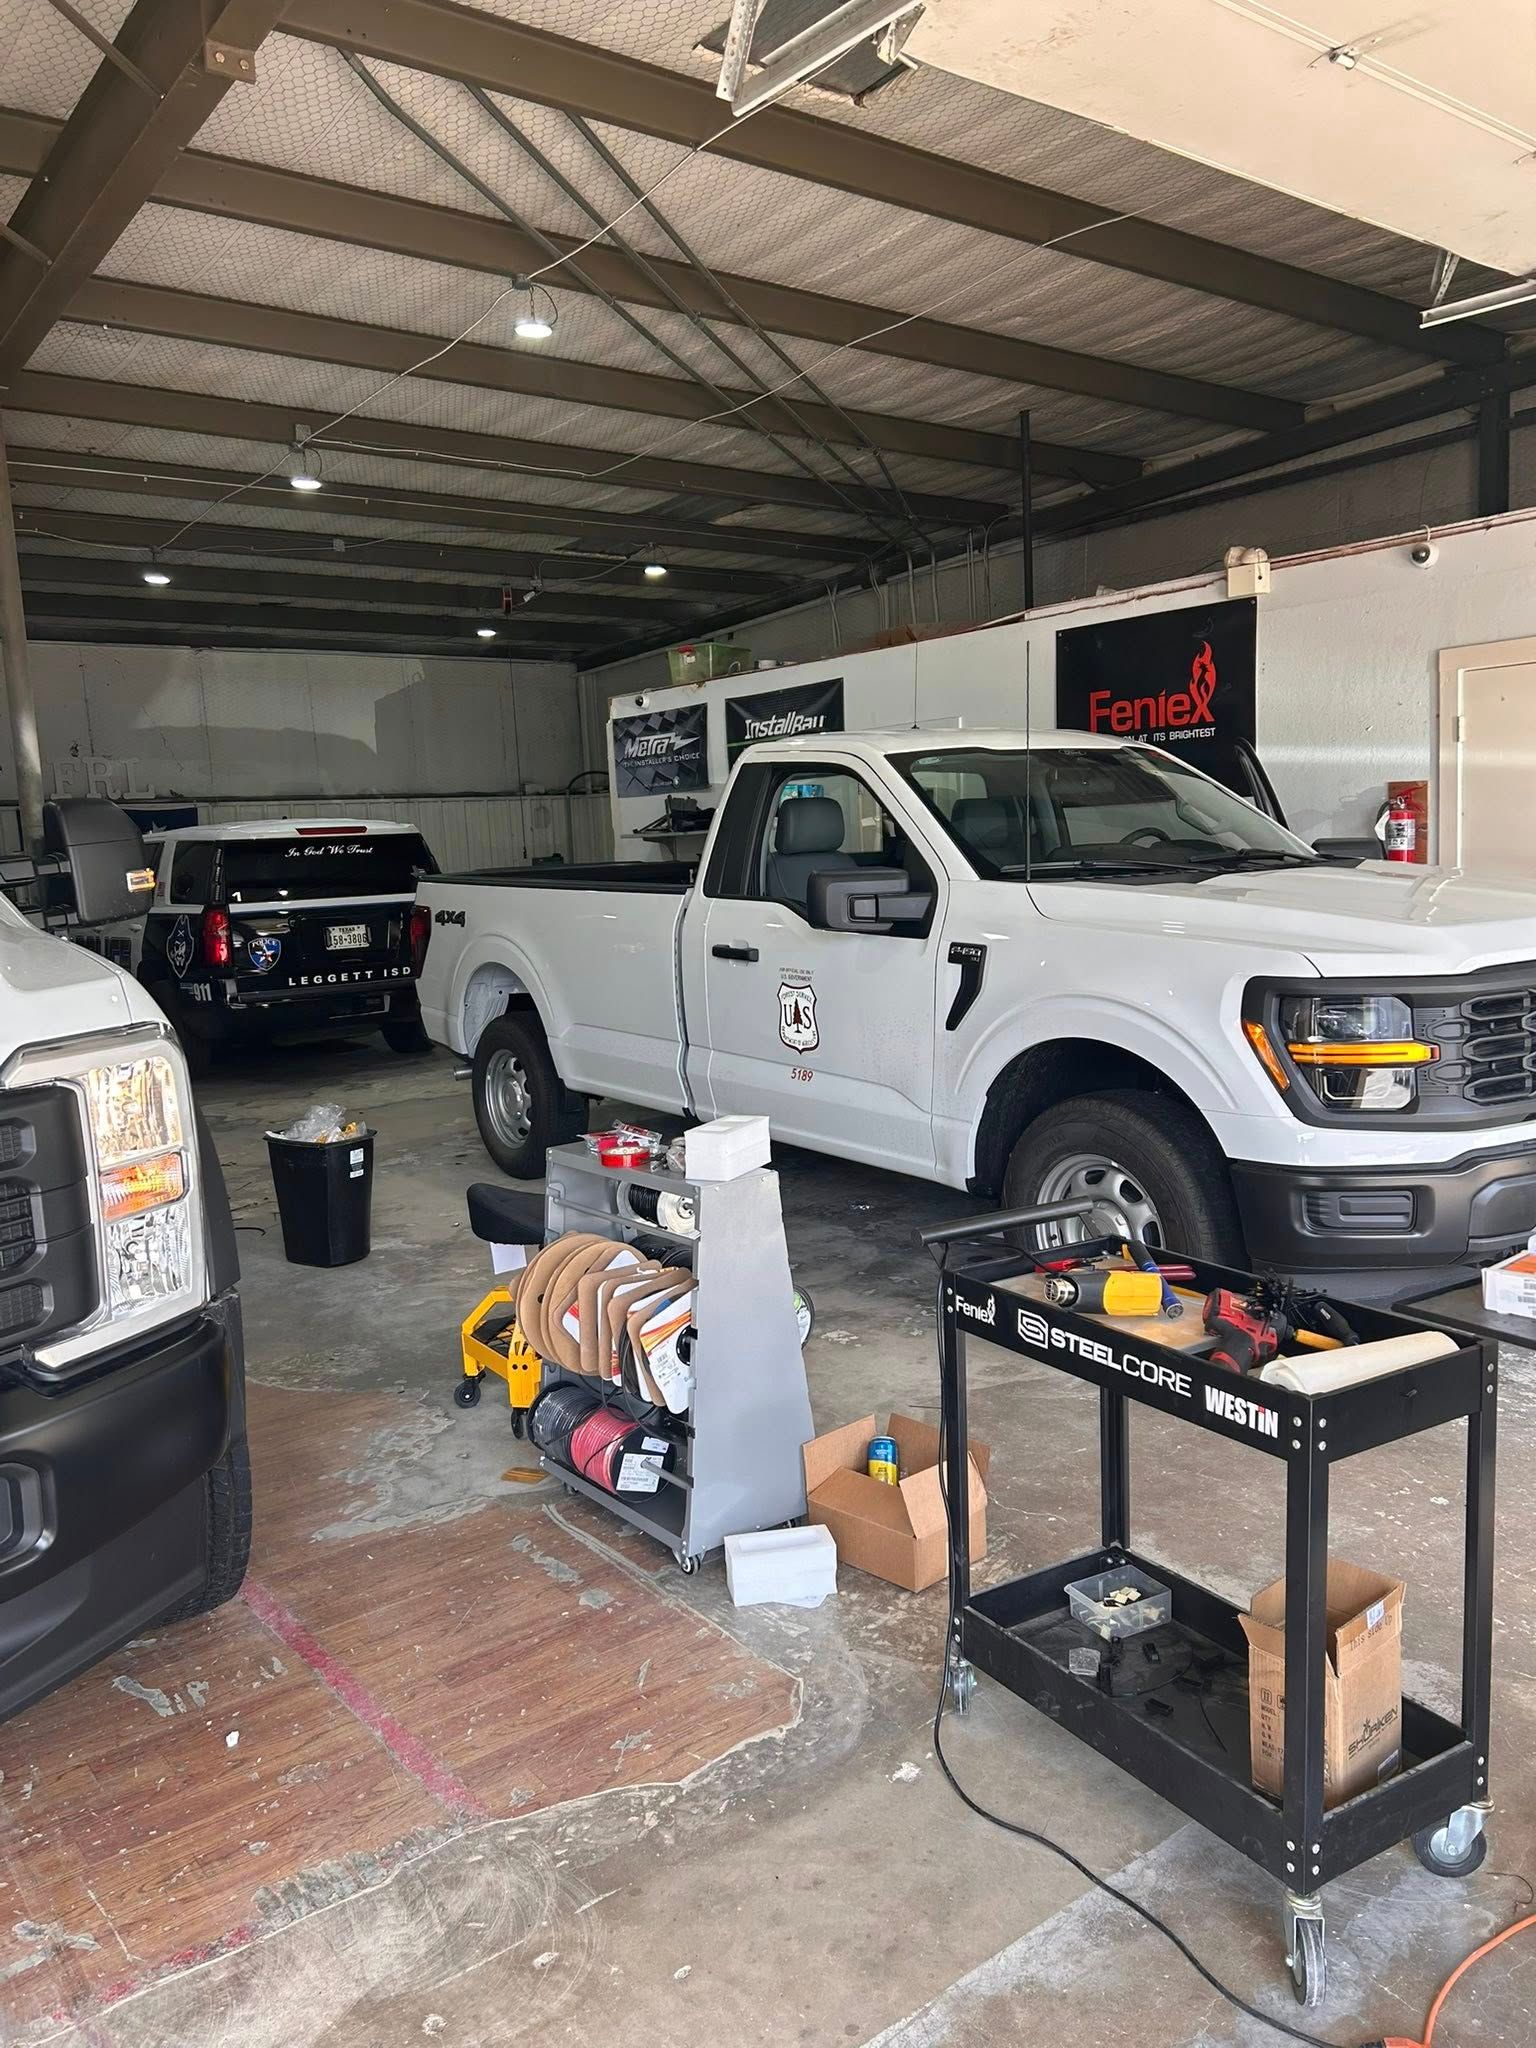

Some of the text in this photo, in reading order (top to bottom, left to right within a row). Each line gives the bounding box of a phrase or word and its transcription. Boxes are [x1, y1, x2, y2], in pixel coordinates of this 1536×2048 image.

[1089, 652, 1217, 734] Feniex
[1153, 732, 1166, 742] ITS
[1169, 727, 1216, 740] BRIGHTEST
[304, 846, 325, 856] God
[327, 845, 345, 855] We
[347, 844, 373, 854] Trust
[288, 966, 411, 986] LEGGETT ISD
[193, 983, 213, 1002] 911
[790, 1068, 814, 1082] 5189
[955, 1293, 995, 1326] Feniex
